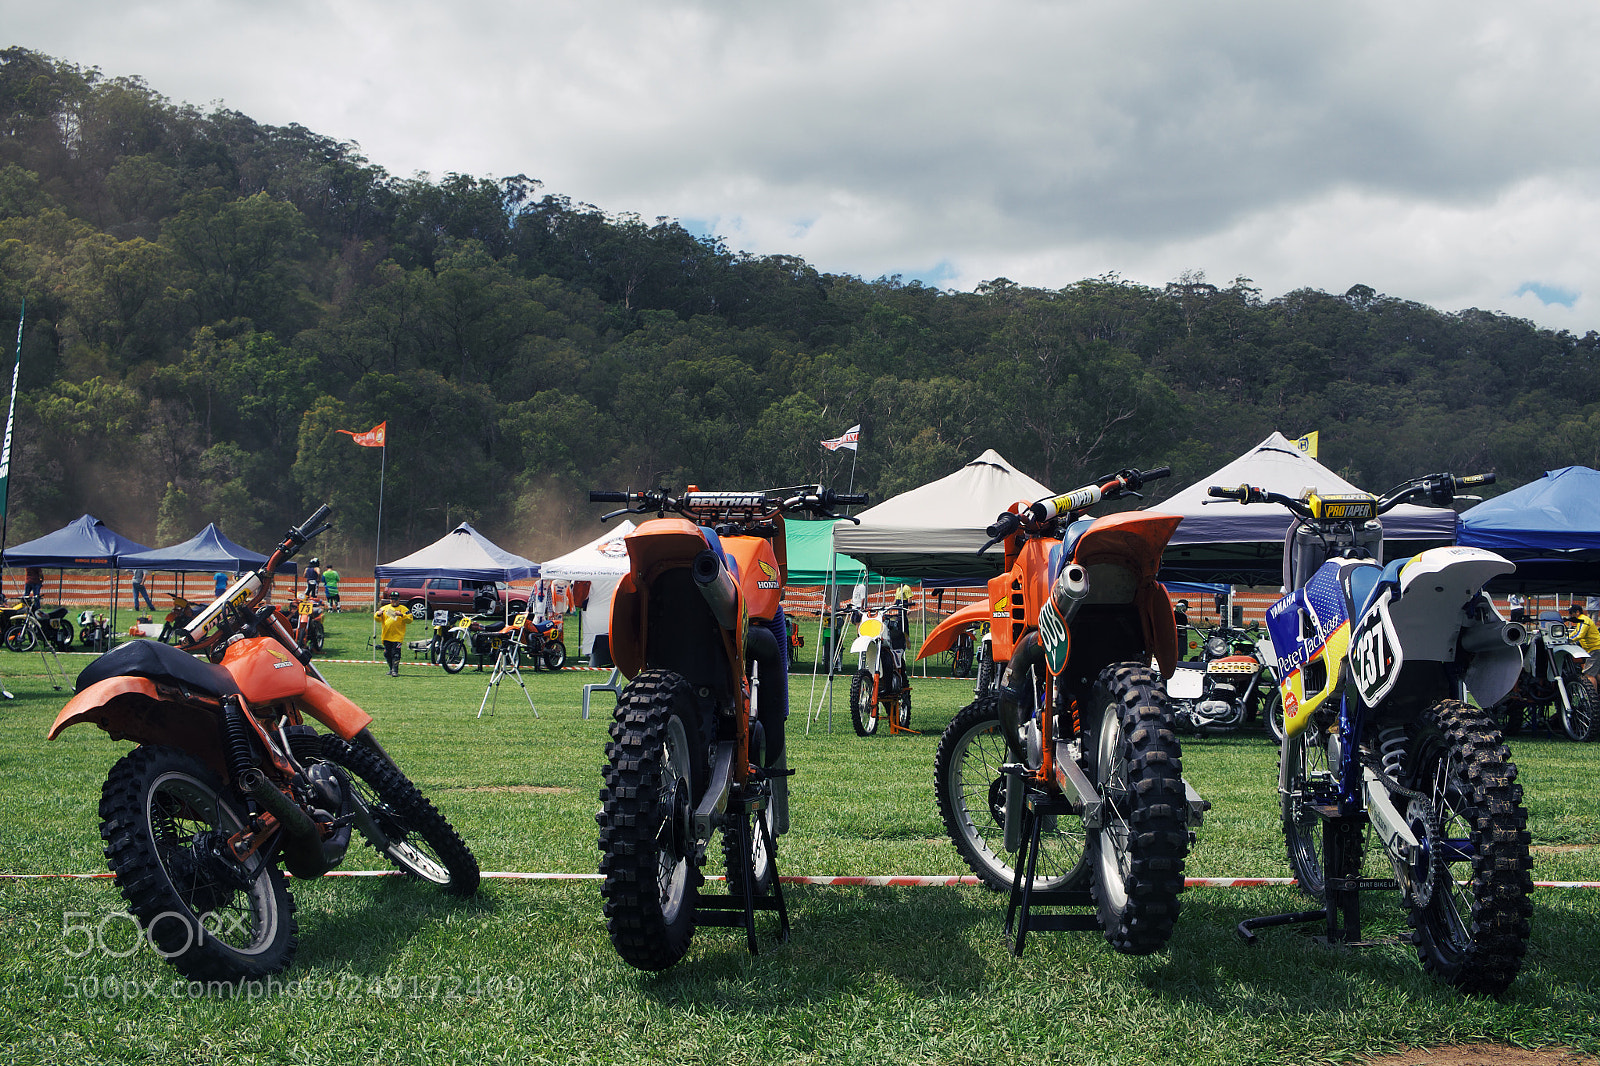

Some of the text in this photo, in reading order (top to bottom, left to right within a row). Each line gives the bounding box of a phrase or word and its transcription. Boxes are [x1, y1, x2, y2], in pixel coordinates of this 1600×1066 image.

[688, 498, 761, 506] RENTHAL
[1327, 504, 1370, 518] PROTAPER
[757, 581, 780, 589] HONDA
[1270, 593, 1296, 619] YAMAHA
[1278, 614, 1339, 678] Peter Jackson
[1355, 621, 1386, 694] 237
